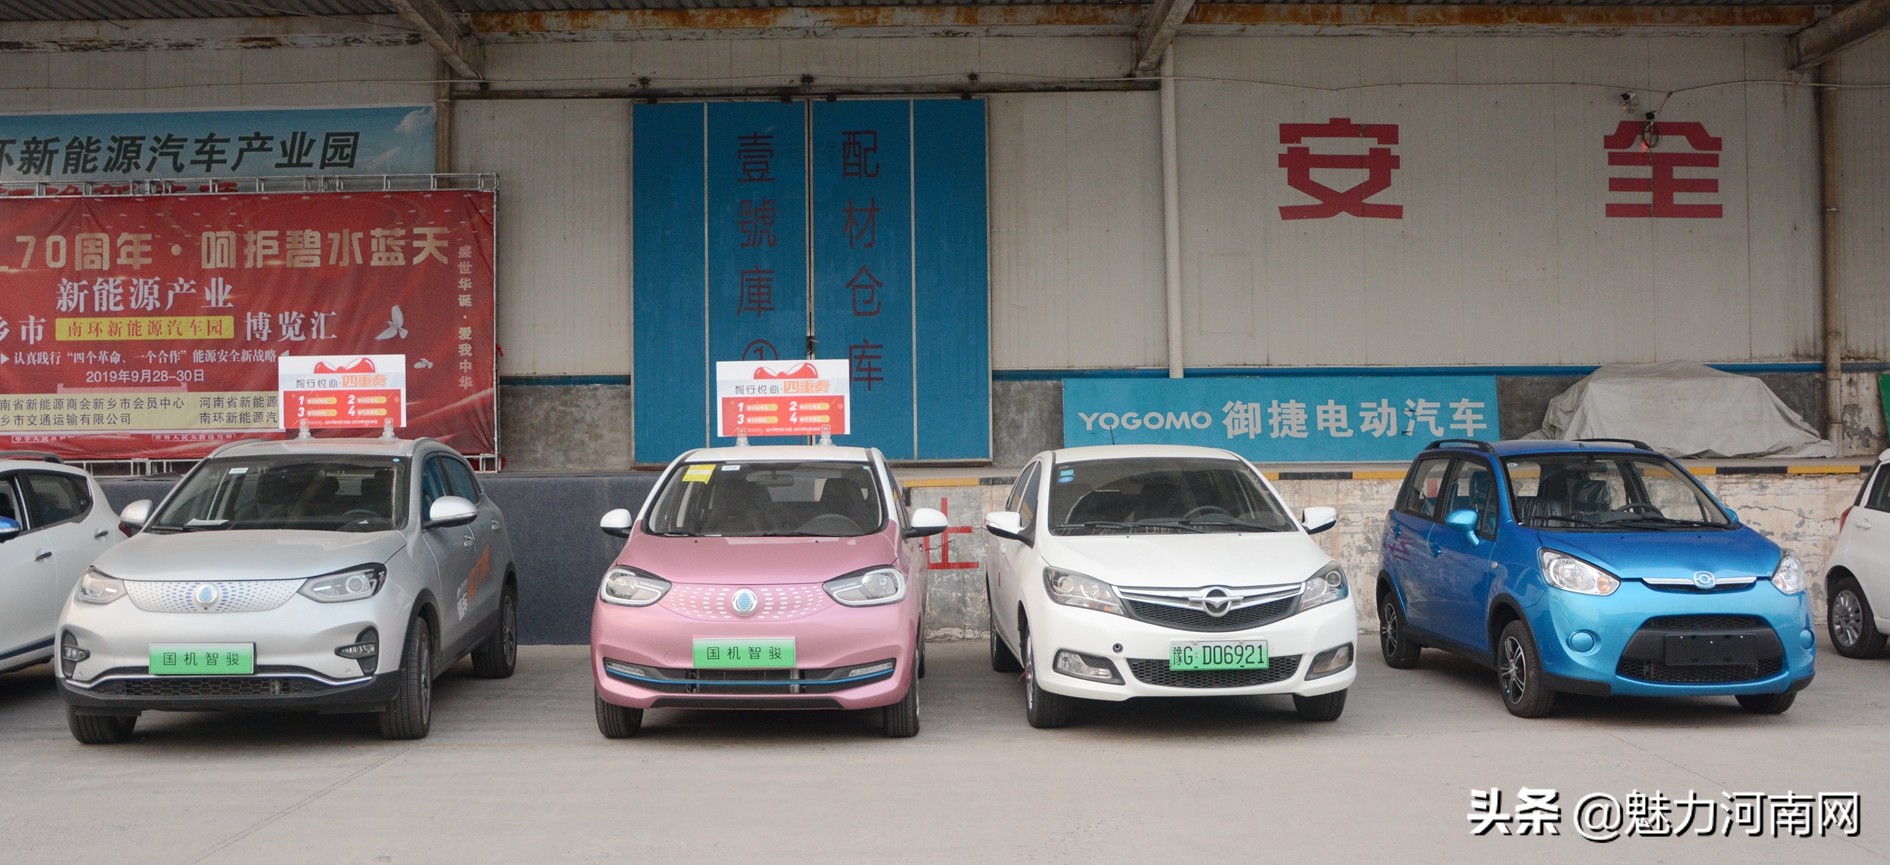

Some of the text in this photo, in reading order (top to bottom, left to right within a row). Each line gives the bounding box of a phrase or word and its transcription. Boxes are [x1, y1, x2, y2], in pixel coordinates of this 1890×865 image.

[1278, 117, 1724, 220] 安全
[0, 226, 449, 271] 70周年·呵护碧水蓝天
[842, 130, 884, 391] 配材仓库
[56, 277, 235, 312] 新能源产业
[67, 318, 224, 338] 南环新能源汽车园
[244, 311, 337, 342] 博览汇
[298, 395, 305, 405] 1
[348, 394, 356, 405] 2
[298, 407, 305, 417] 3
[348, 406, 356, 416] 4
[737, 402, 744, 412] 1
[789, 401, 797, 411] 2
[737, 414, 745, 424] 3
[789, 412, 797, 423] 4
[1078, 399, 1488, 439] YOGOMO 御捷电动汽车
[163, 652, 240, 666] 国机智骏
[707, 646, 782, 660] 国机智骏
